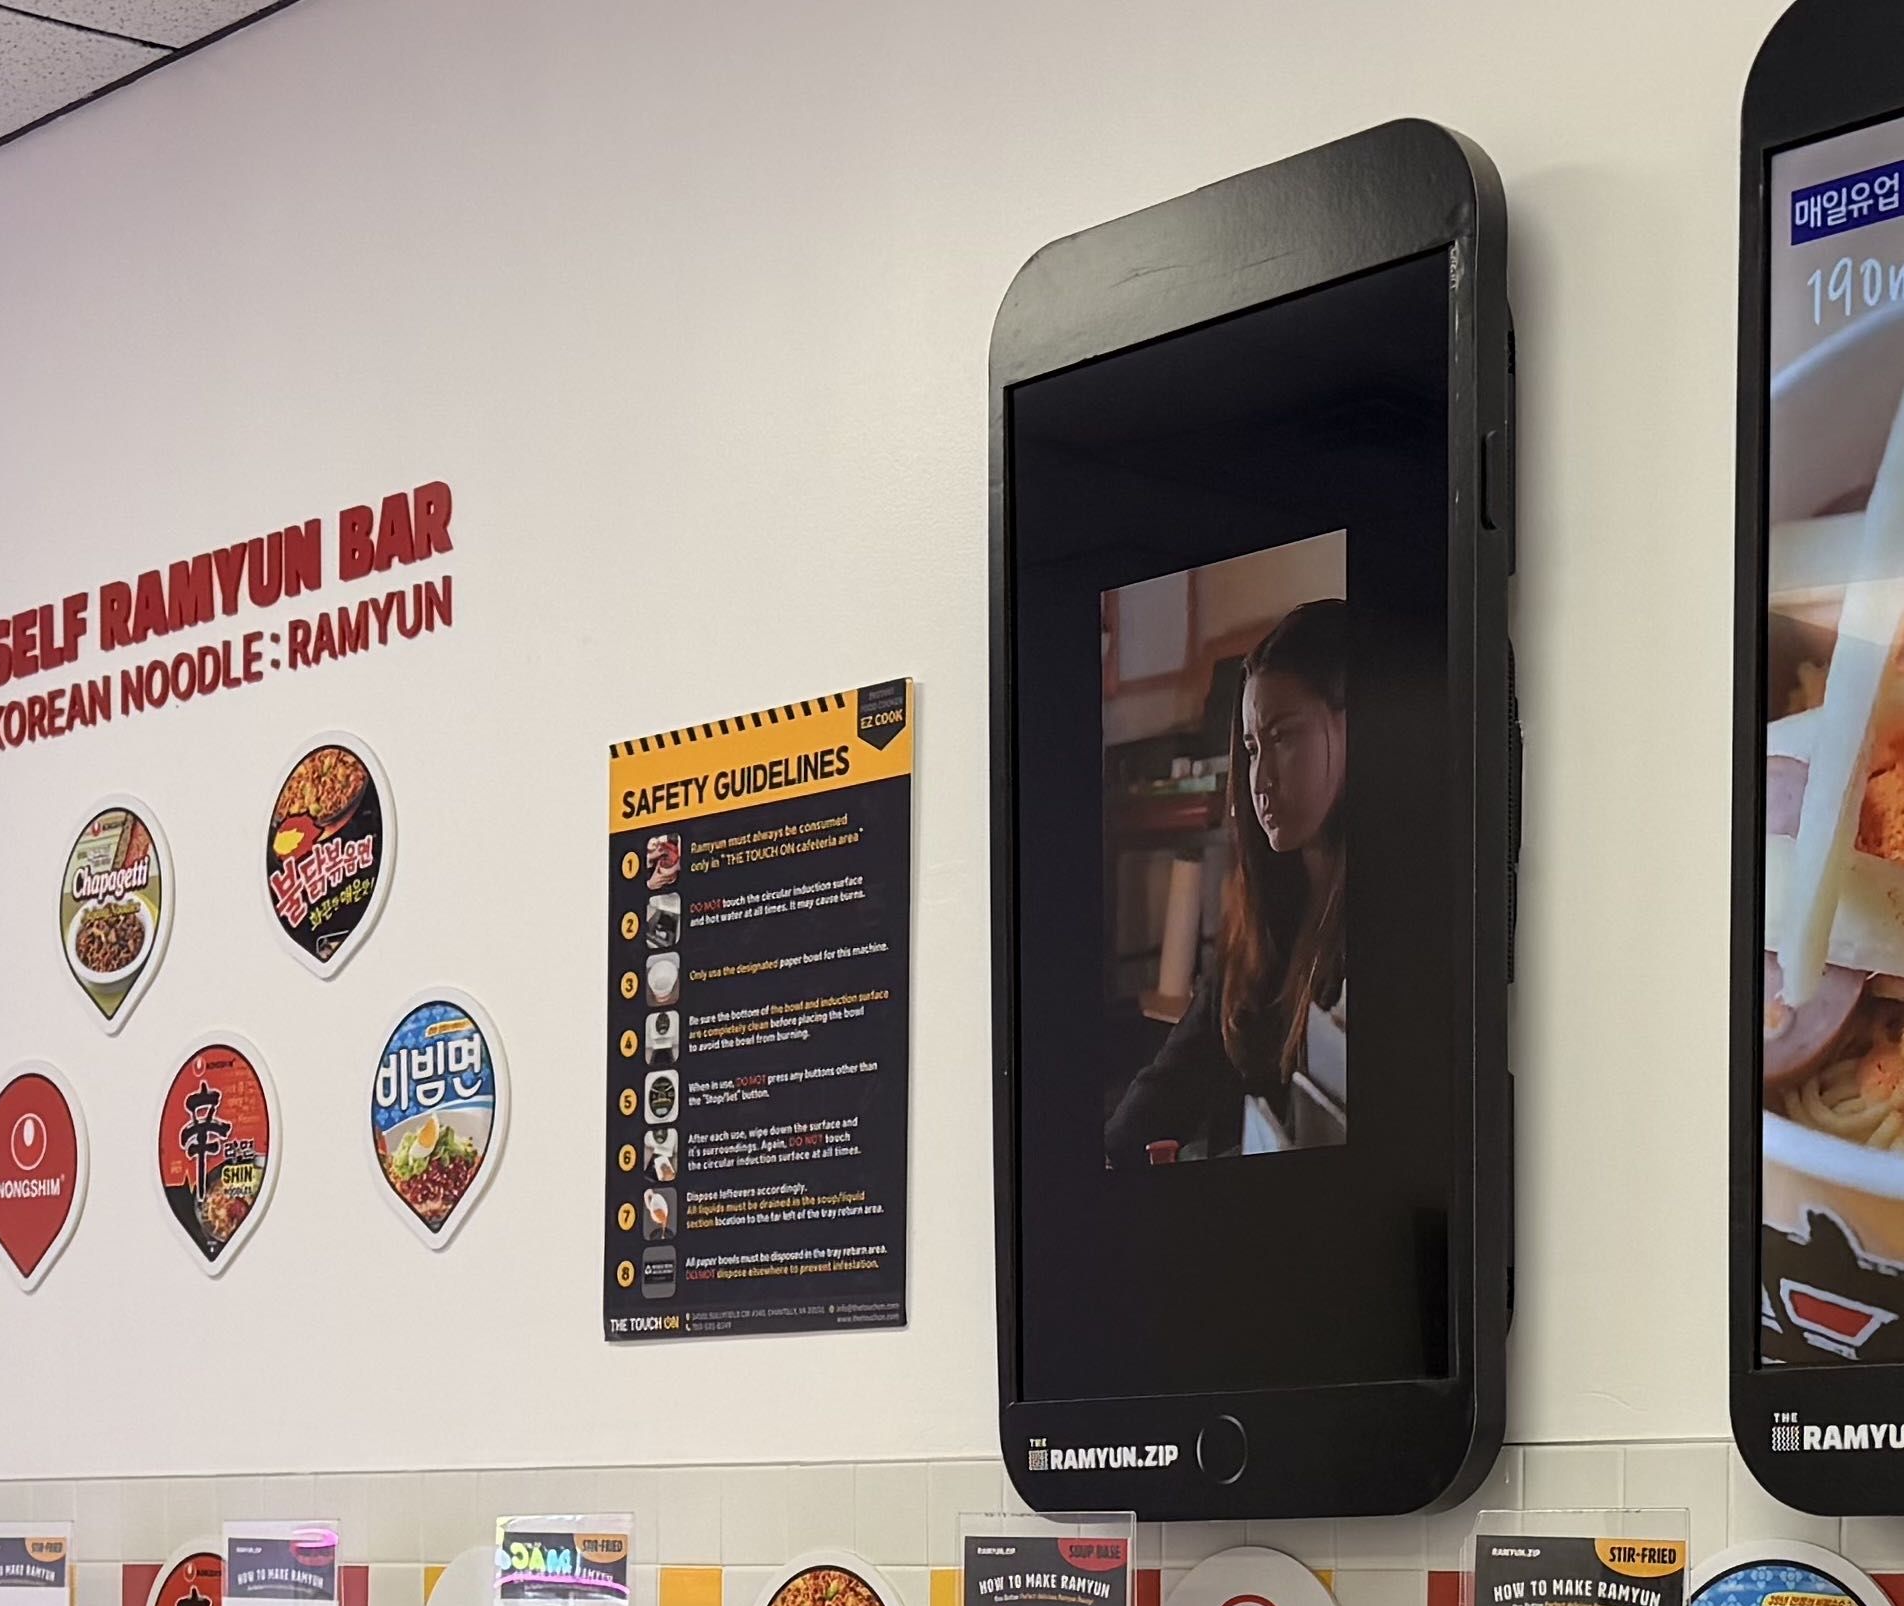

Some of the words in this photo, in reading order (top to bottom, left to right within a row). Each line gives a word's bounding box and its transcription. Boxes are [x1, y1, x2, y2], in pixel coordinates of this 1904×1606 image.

[1794, 170, 1900, 229] 매일유업
[100, 518, 321, 651] RAMYUN
[338, 480, 453, 581] BAR
[120, 631, 263, 715] NOODLE
[288, 575, 453, 669] RAMYUN
[875, 709, 903, 728] COOK
[622, 775, 709, 819] SAFETY
[714, 746, 849, 801] GUIDELINES
[73, 856, 149, 903] Chapagetti
[271, 836, 374, 927] 불닭볶음면
[378, 1033, 483, 1109] 비빔면
[181, 1083, 229, 1199] 辛
[1050, 1445, 1179, 1470] RAMYUN.ZIP
[1609, 1546, 1676, 1564] STIR-FRIED
